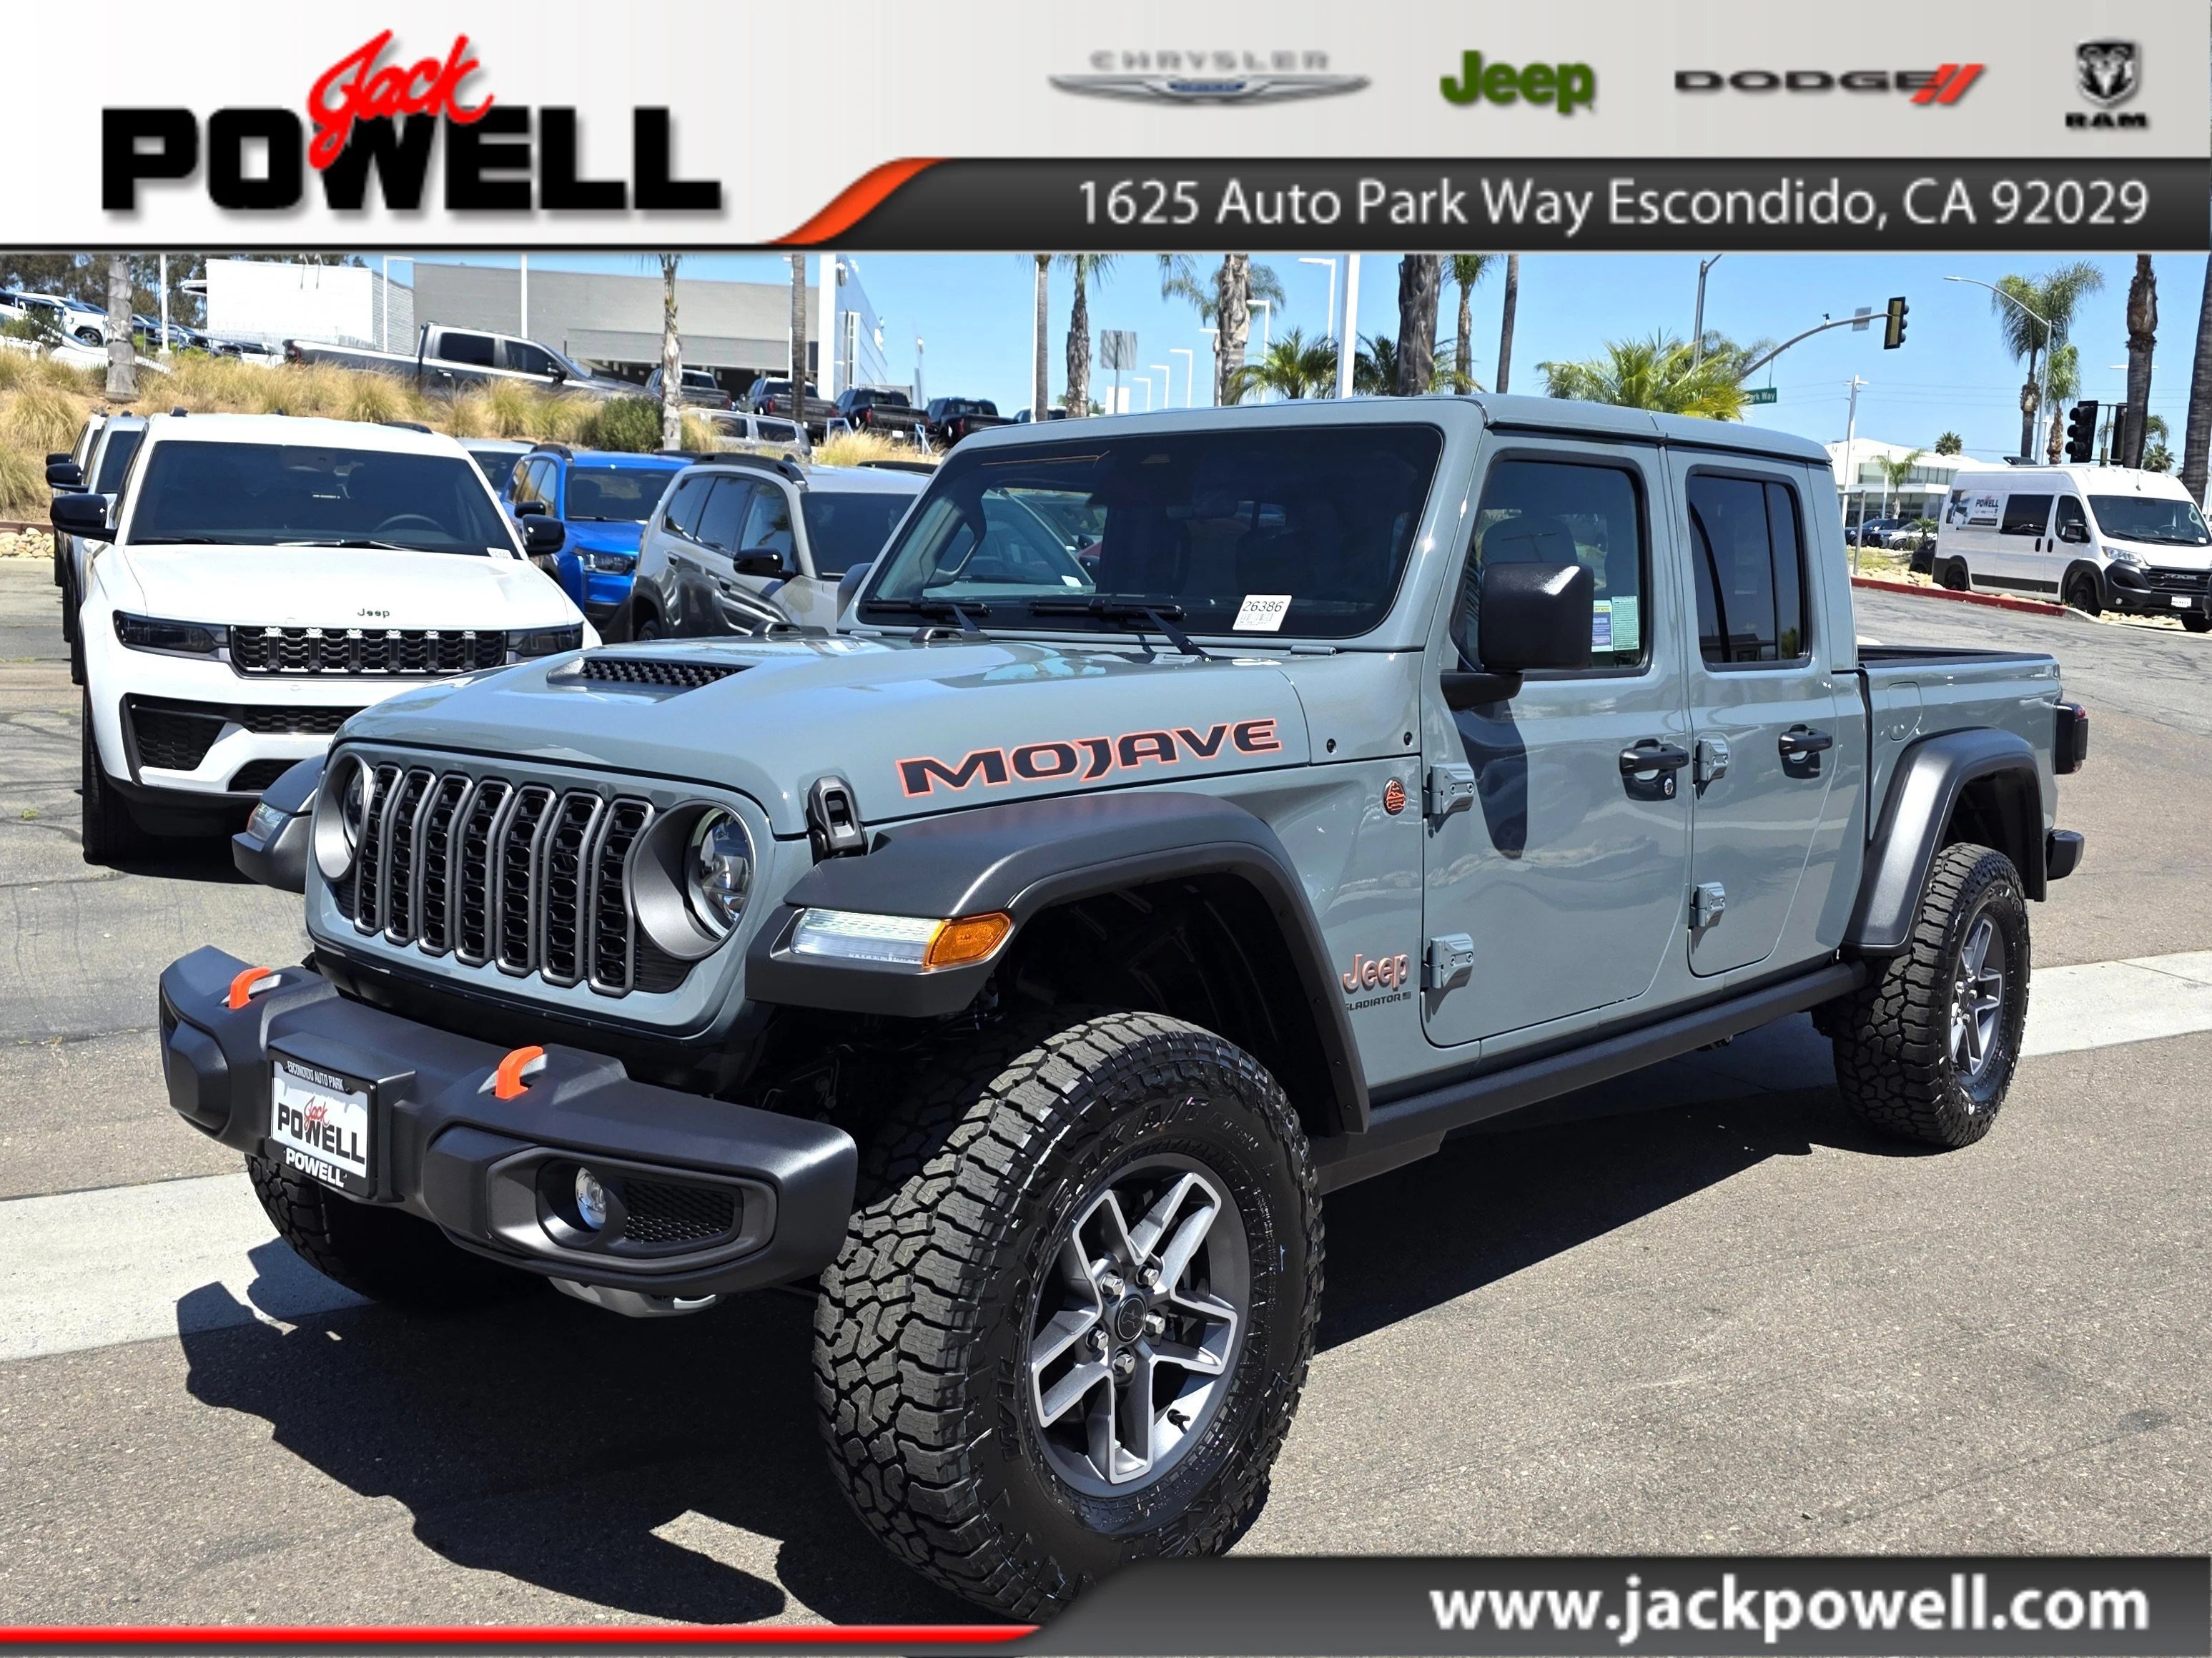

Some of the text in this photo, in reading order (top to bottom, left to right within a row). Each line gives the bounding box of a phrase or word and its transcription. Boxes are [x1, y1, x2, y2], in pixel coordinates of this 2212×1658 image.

[357, 608, 390, 618] Jeep
[1243, 601, 1284, 612] 26386
[895, 717, 1283, 797] MOJAVE
[1343, 953, 1410, 991] Jeep
[304, 1095, 330, 1129] Jack
[277, 1102, 365, 1165] POWELL
[286, 1147, 345, 1188] POWELL
